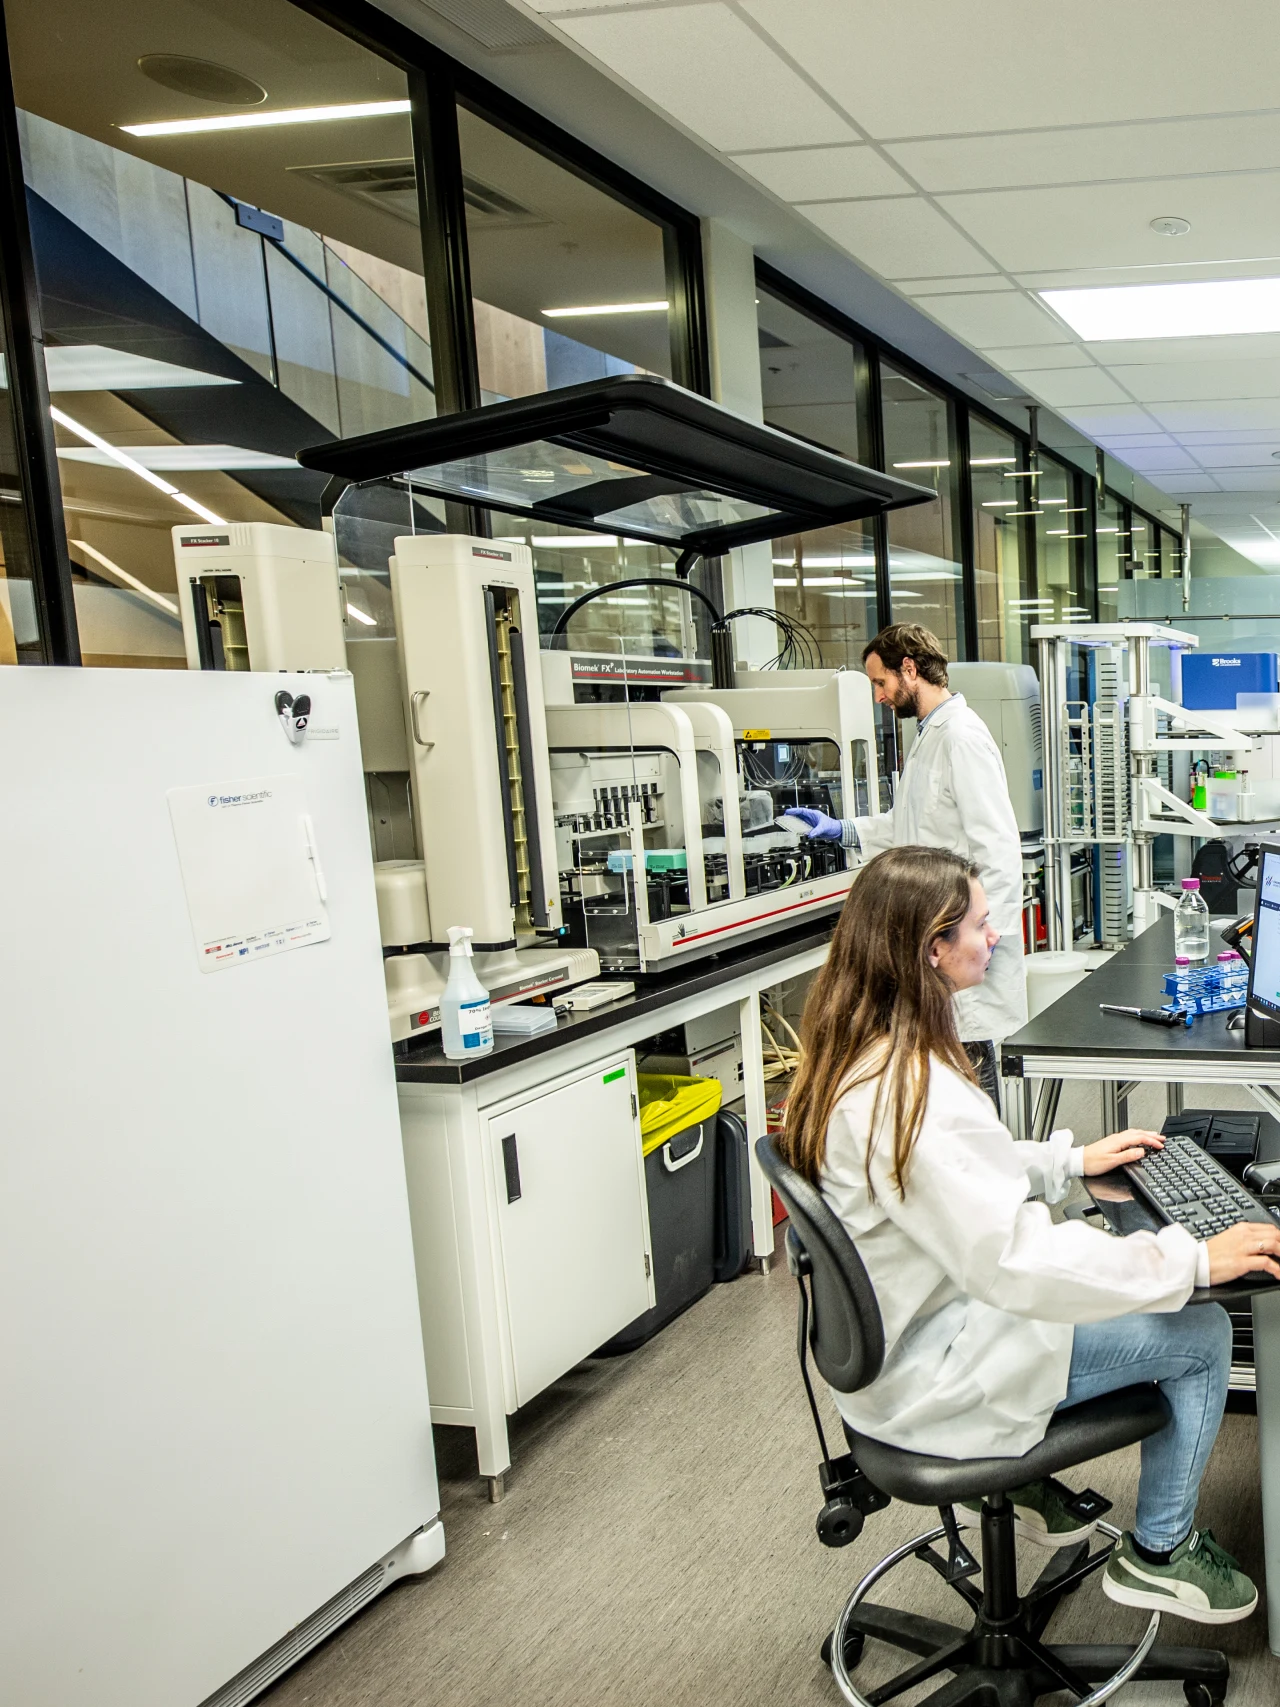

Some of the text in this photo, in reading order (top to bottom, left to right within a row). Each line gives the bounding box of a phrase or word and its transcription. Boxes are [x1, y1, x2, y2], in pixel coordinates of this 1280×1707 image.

[573, 662, 600, 672] Biomek
[219, 795, 242, 805] fisher
[242, 790, 273, 801] scientific
